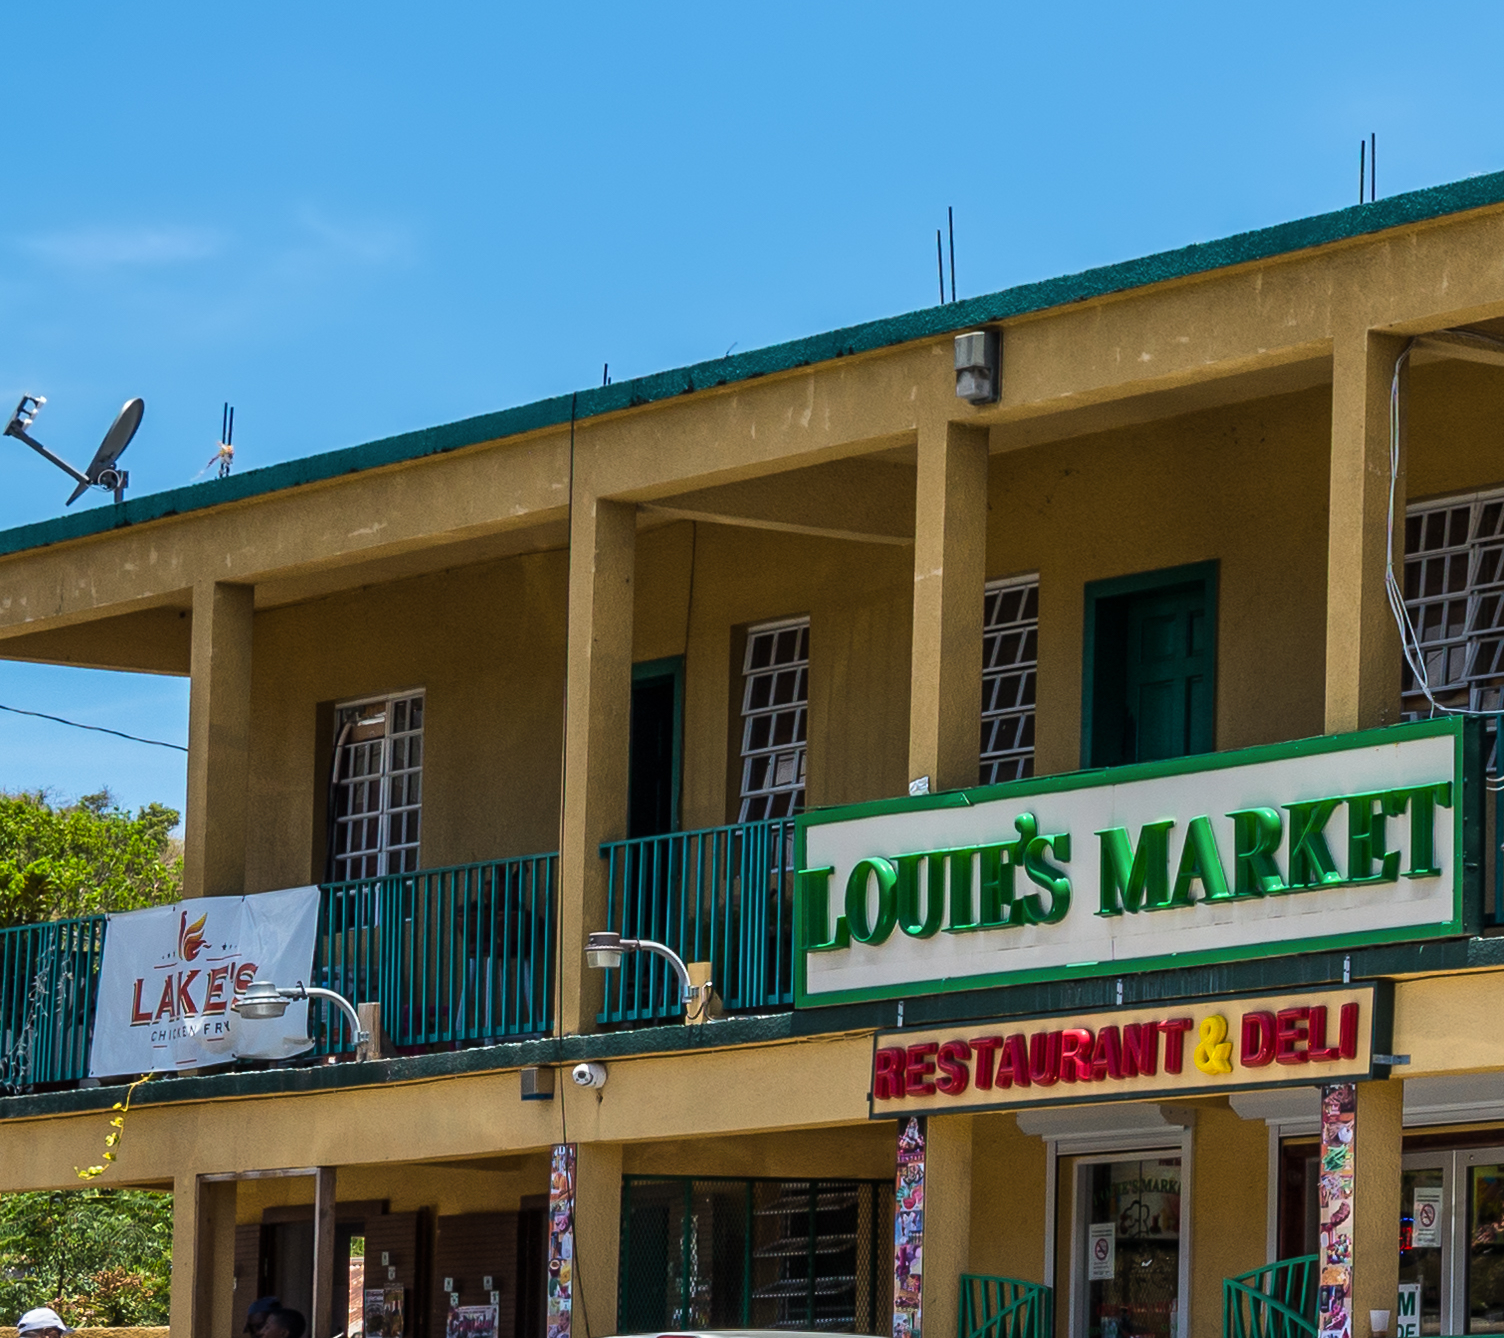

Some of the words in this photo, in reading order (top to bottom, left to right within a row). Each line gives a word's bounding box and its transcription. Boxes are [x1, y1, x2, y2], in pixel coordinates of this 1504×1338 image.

[798, 812, 1071, 953] LOUIE'S
[1094, 780, 1453, 918] MARKET
[130, 962, 259, 1027] LAKE'S
[873, 1017, 1193, 1099] RESTAURANT
[1194, 1014, 1233, 1076] &
[1240, 1001, 1359, 1068] DELI
